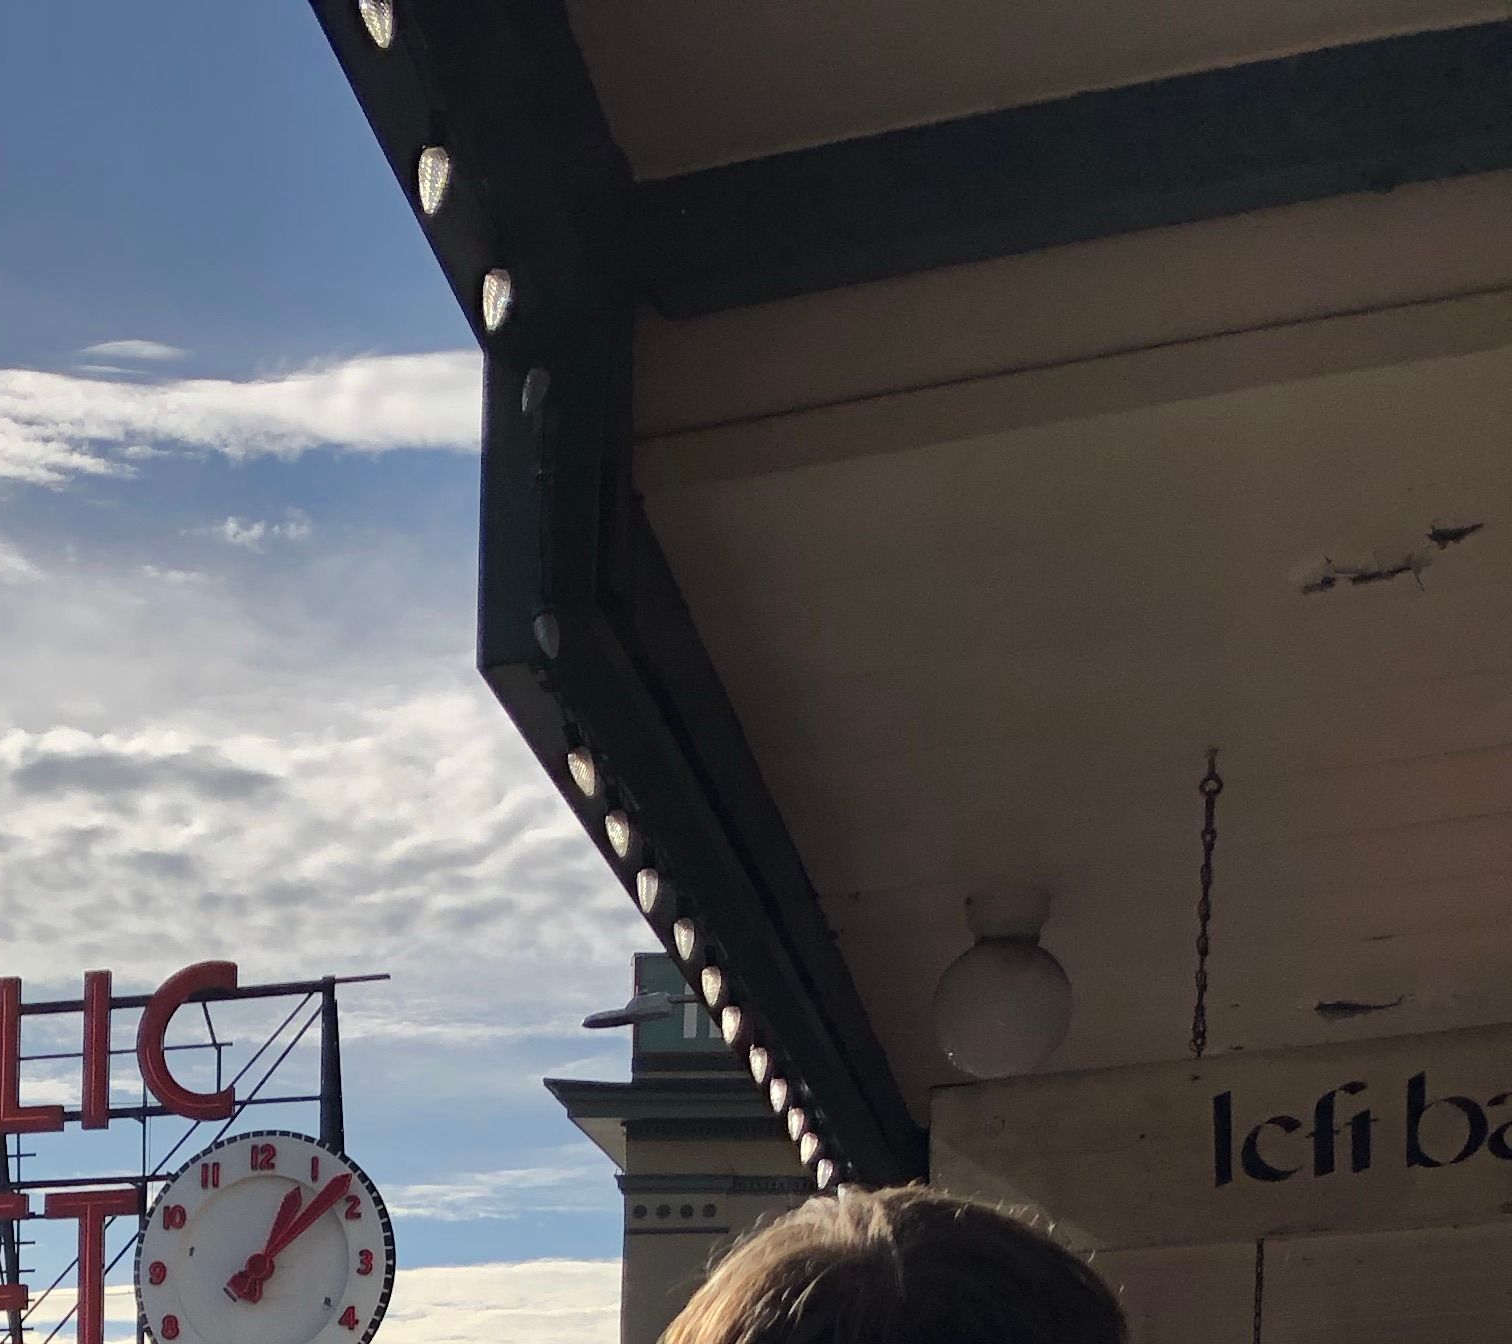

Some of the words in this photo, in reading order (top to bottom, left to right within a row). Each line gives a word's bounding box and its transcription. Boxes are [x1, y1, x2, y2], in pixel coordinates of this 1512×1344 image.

[250, 1143, 276, 1171] 12
[310, 1156, 320, 1182] 1
[201, 1162, 220, 1188] 11
[162, 1205, 186, 1230] 10
[344, 1194, 362, 1220] 2
[148, 1261, 167, 1286] 9
[356, 1249, 374, 1276] 3
[161, 1314, 180, 1340] 8
[338, 1305, 359, 1330] 4
